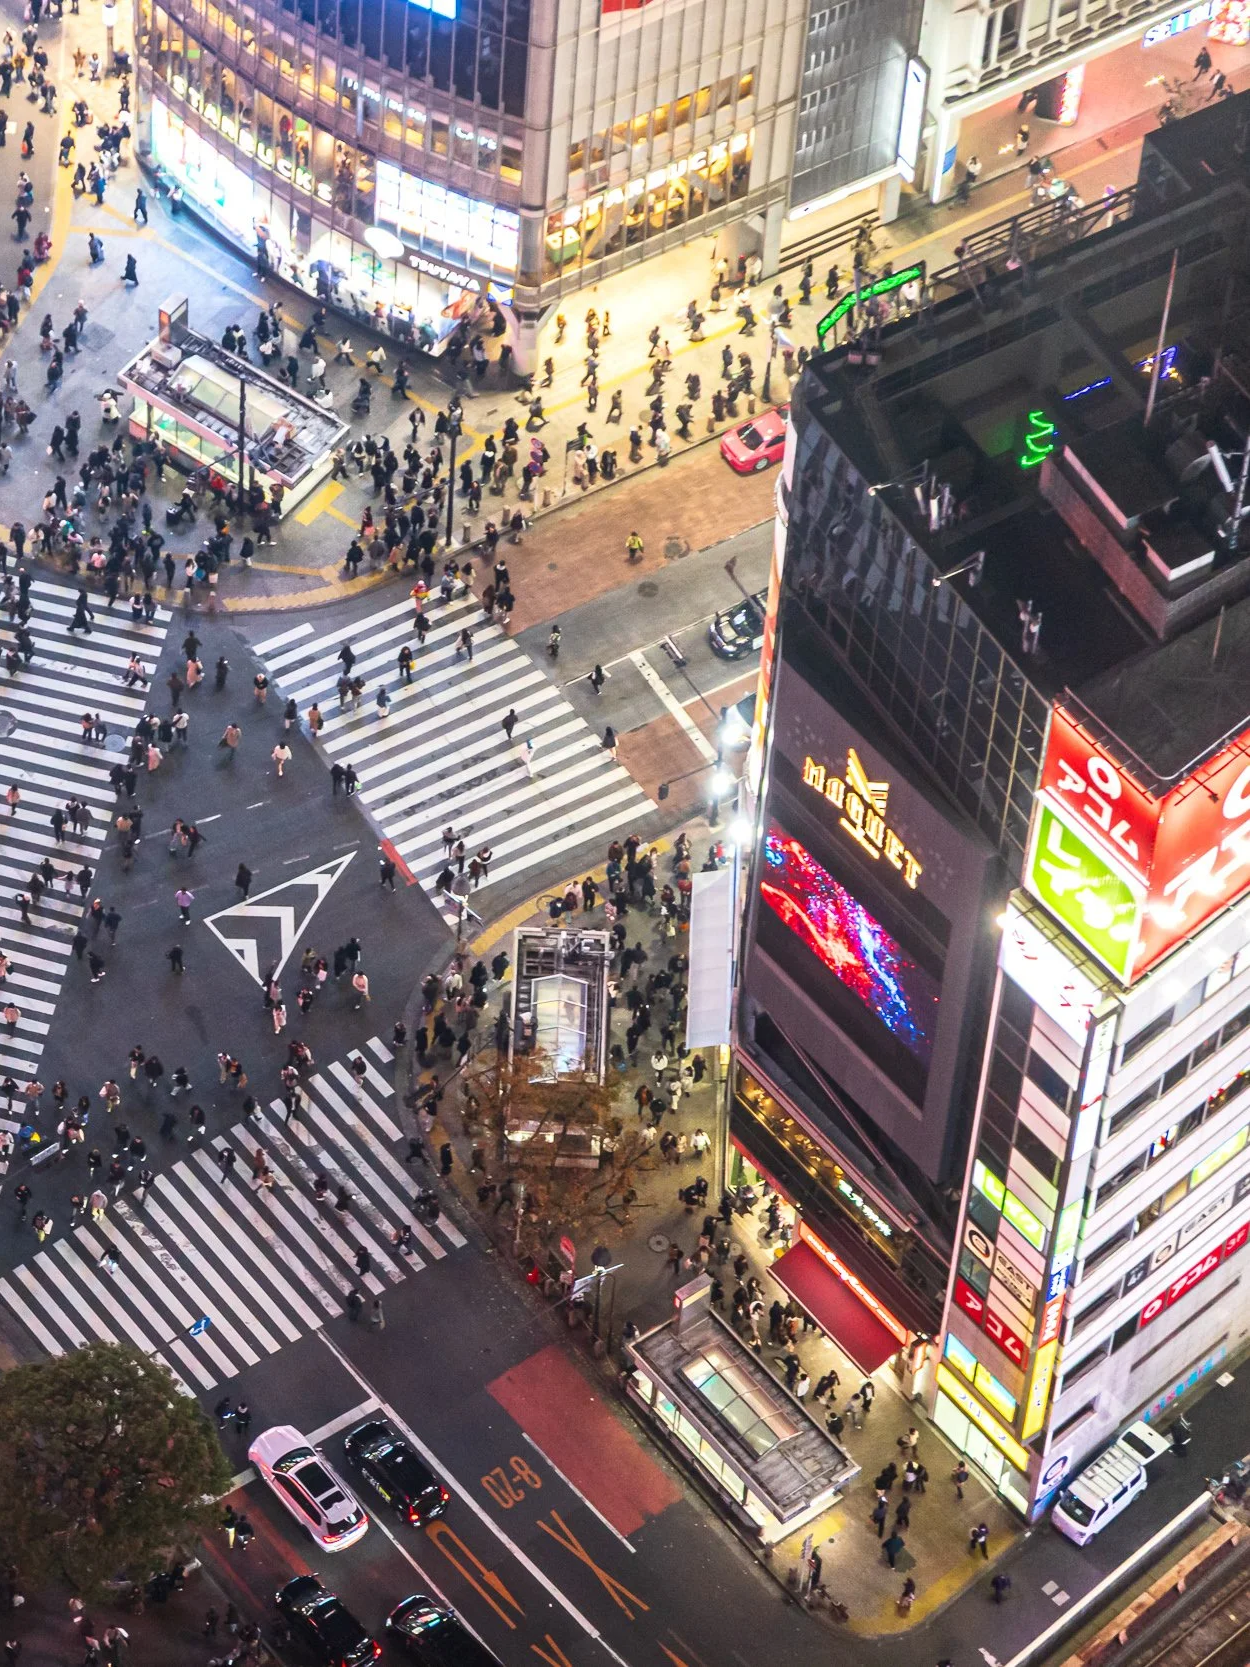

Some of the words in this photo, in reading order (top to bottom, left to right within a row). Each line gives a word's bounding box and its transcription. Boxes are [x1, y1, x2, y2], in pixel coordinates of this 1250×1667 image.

[172, 74, 333, 201] STARBUCKS
[563, 132, 748, 227] STARBUCKS
[409, 255, 481, 292] TSUTAYA
[1058, 758, 1139, 861] アコム
[1171, 1255, 1218, 1299] アコム
[965, 1290, 1021, 1360] アコム
[480, 1455, 542, 1509] 8-20
